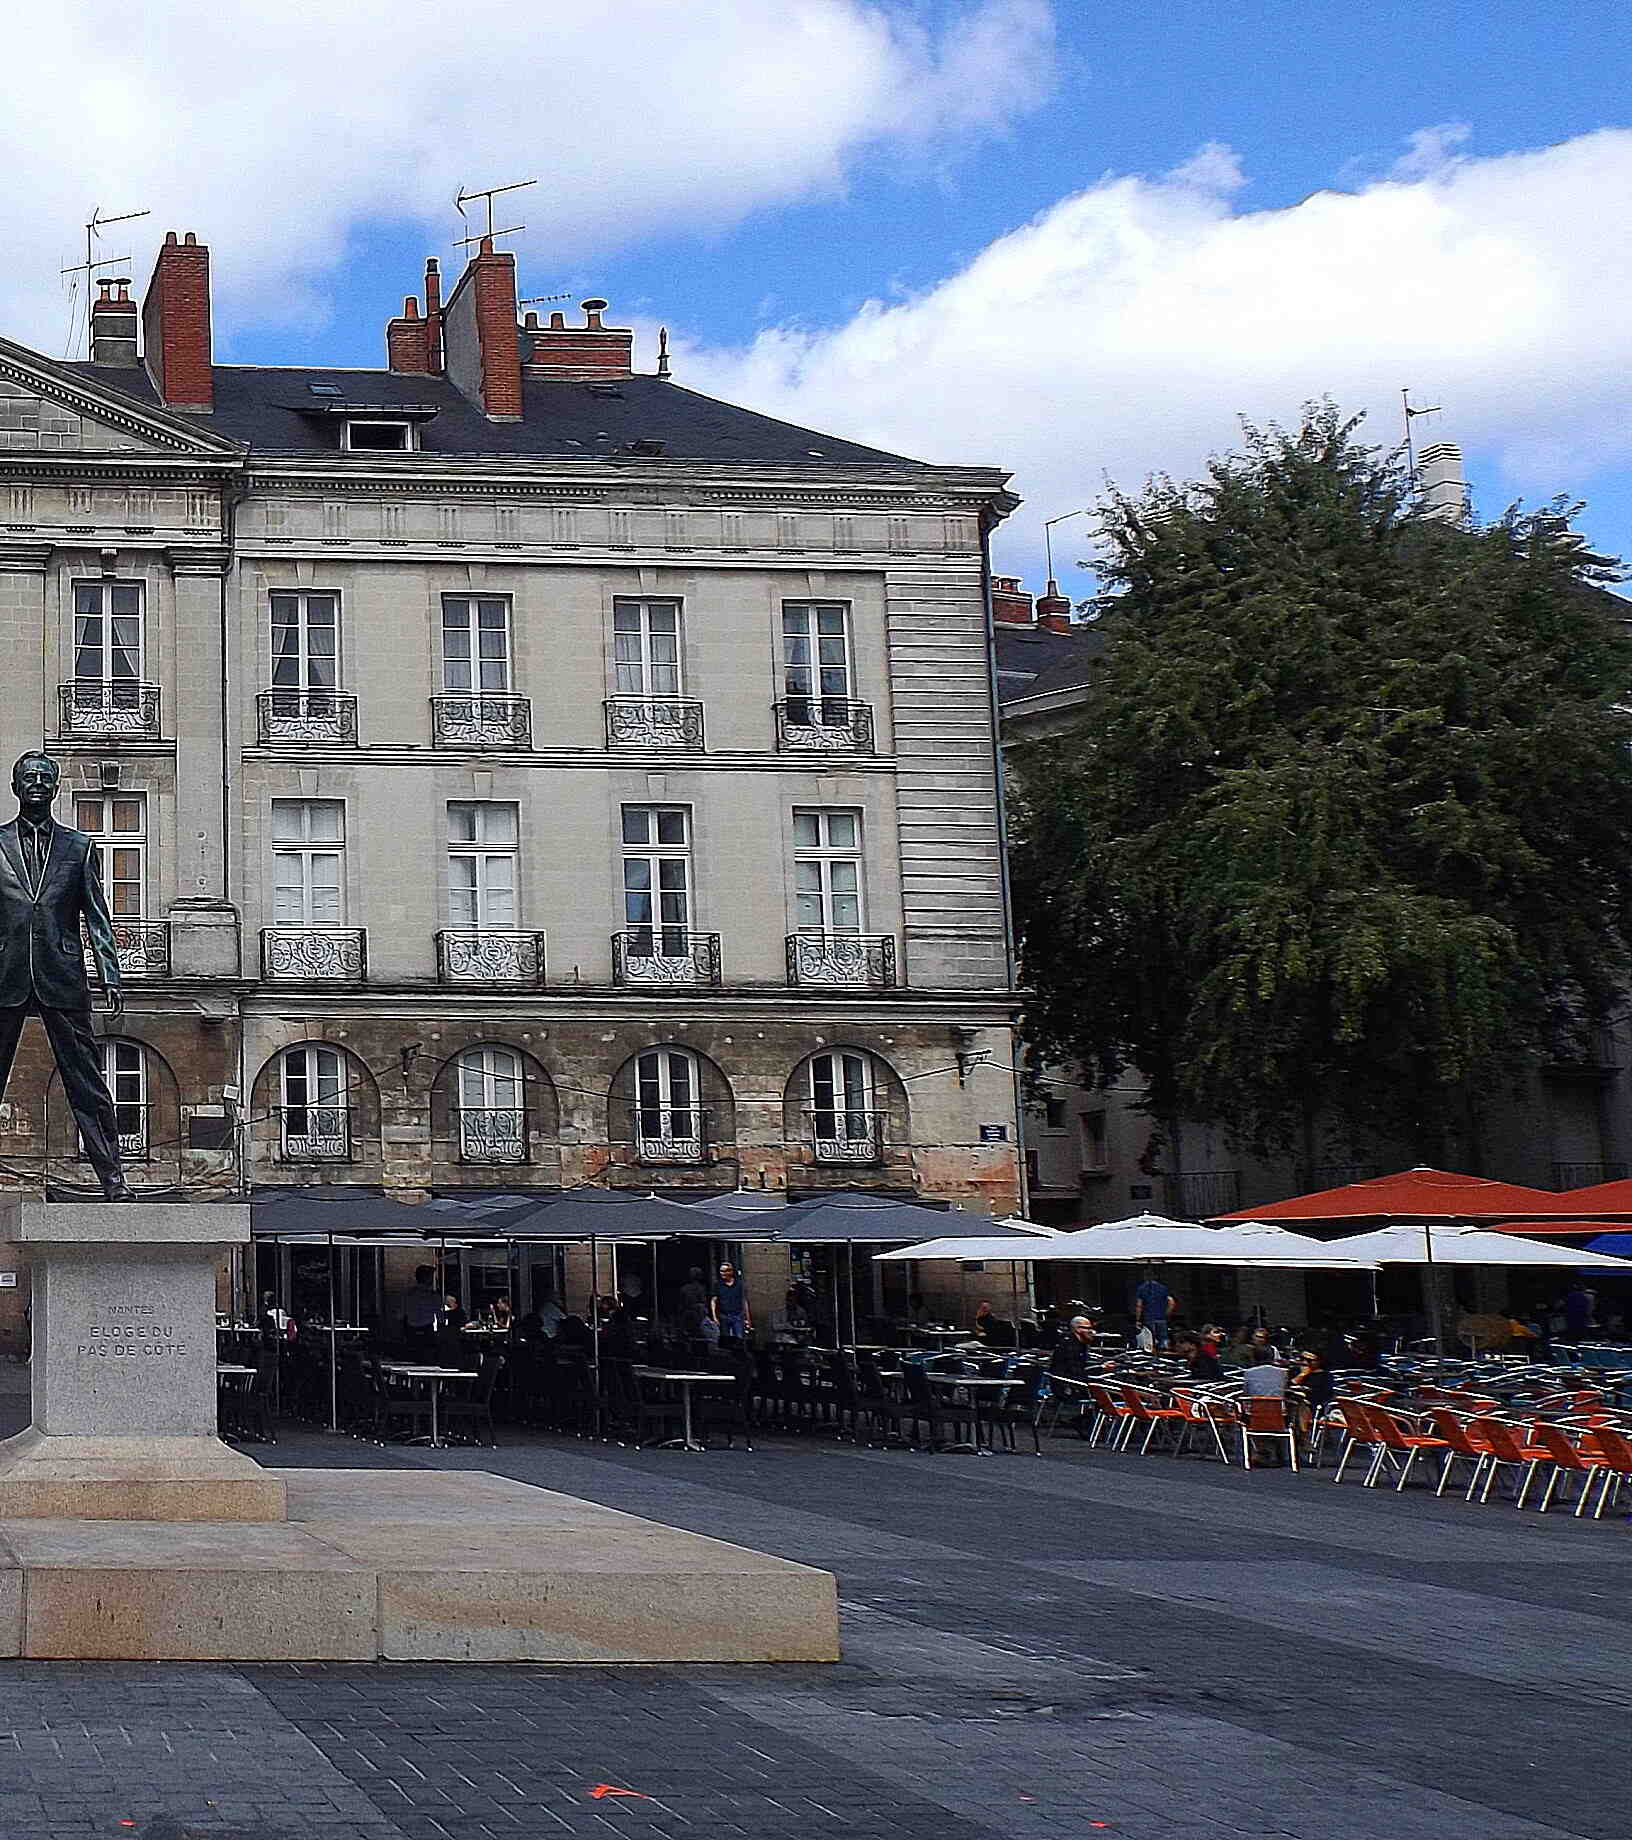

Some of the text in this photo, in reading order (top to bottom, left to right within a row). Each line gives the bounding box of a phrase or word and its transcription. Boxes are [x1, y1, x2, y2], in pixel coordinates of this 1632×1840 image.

[108, 1305, 155, 1315] NANTES
[152, 1326, 173, 1338] DU
[77, 1344, 108, 1357] PAS
[114, 1344, 137, 1356] DE
